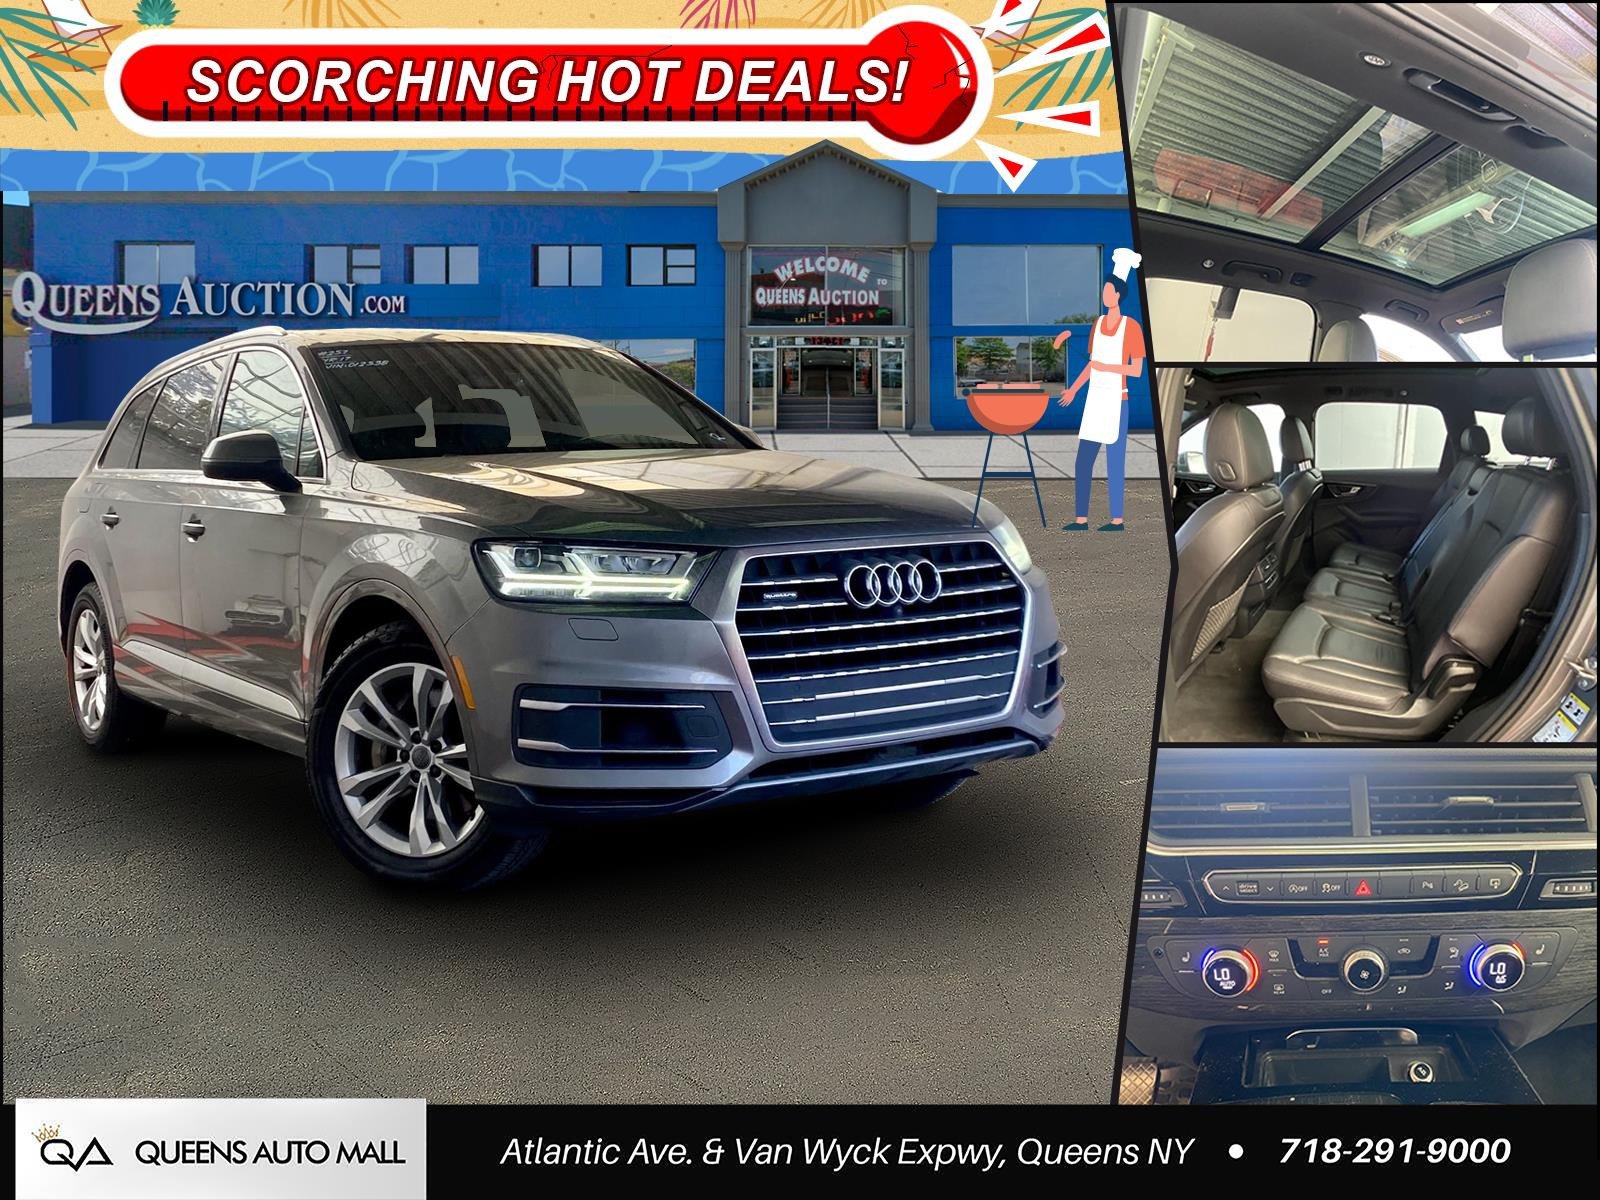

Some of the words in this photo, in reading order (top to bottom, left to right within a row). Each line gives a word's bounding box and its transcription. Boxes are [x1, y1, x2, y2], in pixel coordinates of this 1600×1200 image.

[773, 255, 871, 284] WELCOME
[877, 278, 888, 286] TO
[11, 271, 161, 335] QUEENS
[169, 276, 357, 317] AUCTION
[754, 287, 806, 306] QUEENS
[807, 287, 880, 306] AUCTION
[1213, 967, 1231, 981] LO
[1489, 962, 1506, 975] LO
